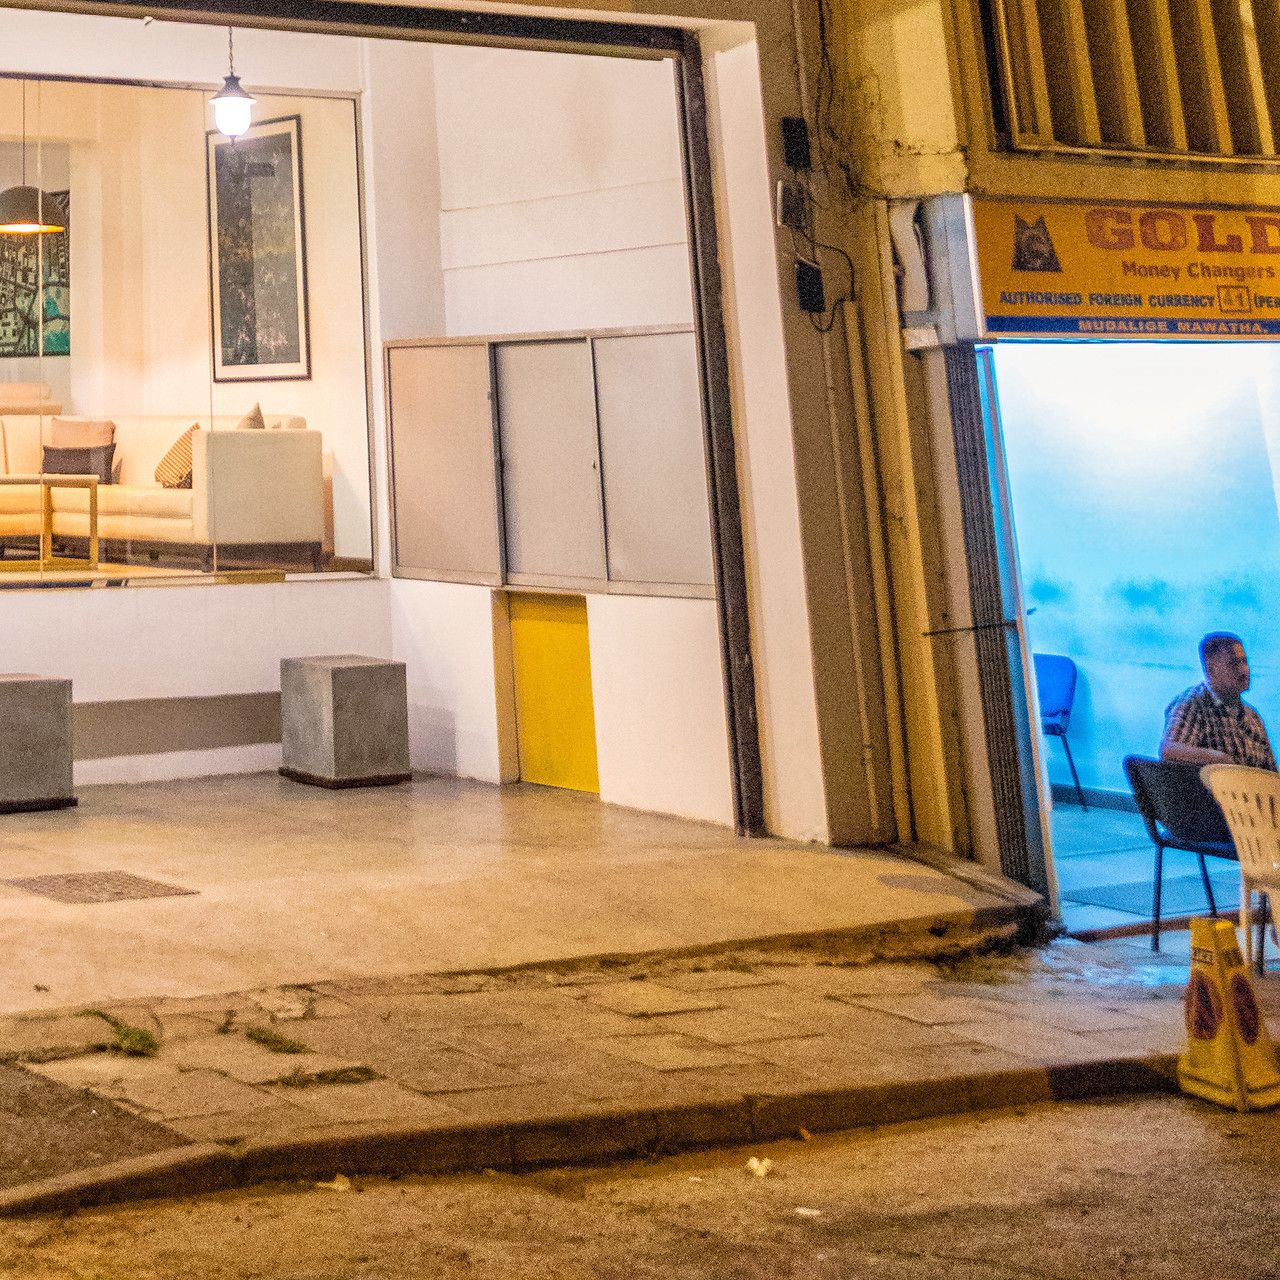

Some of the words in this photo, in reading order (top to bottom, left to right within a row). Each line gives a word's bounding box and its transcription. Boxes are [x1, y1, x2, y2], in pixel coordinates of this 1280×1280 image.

[1085, 208, 1280, 254] GOLD
[1122, 260, 1180, 281] Money
[1186, 261, 1275, 282] Changers
[1000, 291, 1081, 305] AUTHORISED
[1089, 293, 1142, 307] FOREIGN
[1148, 294, 1215, 308] CURRENCY
[1078, 320, 1167, 331] MUDALIGE
